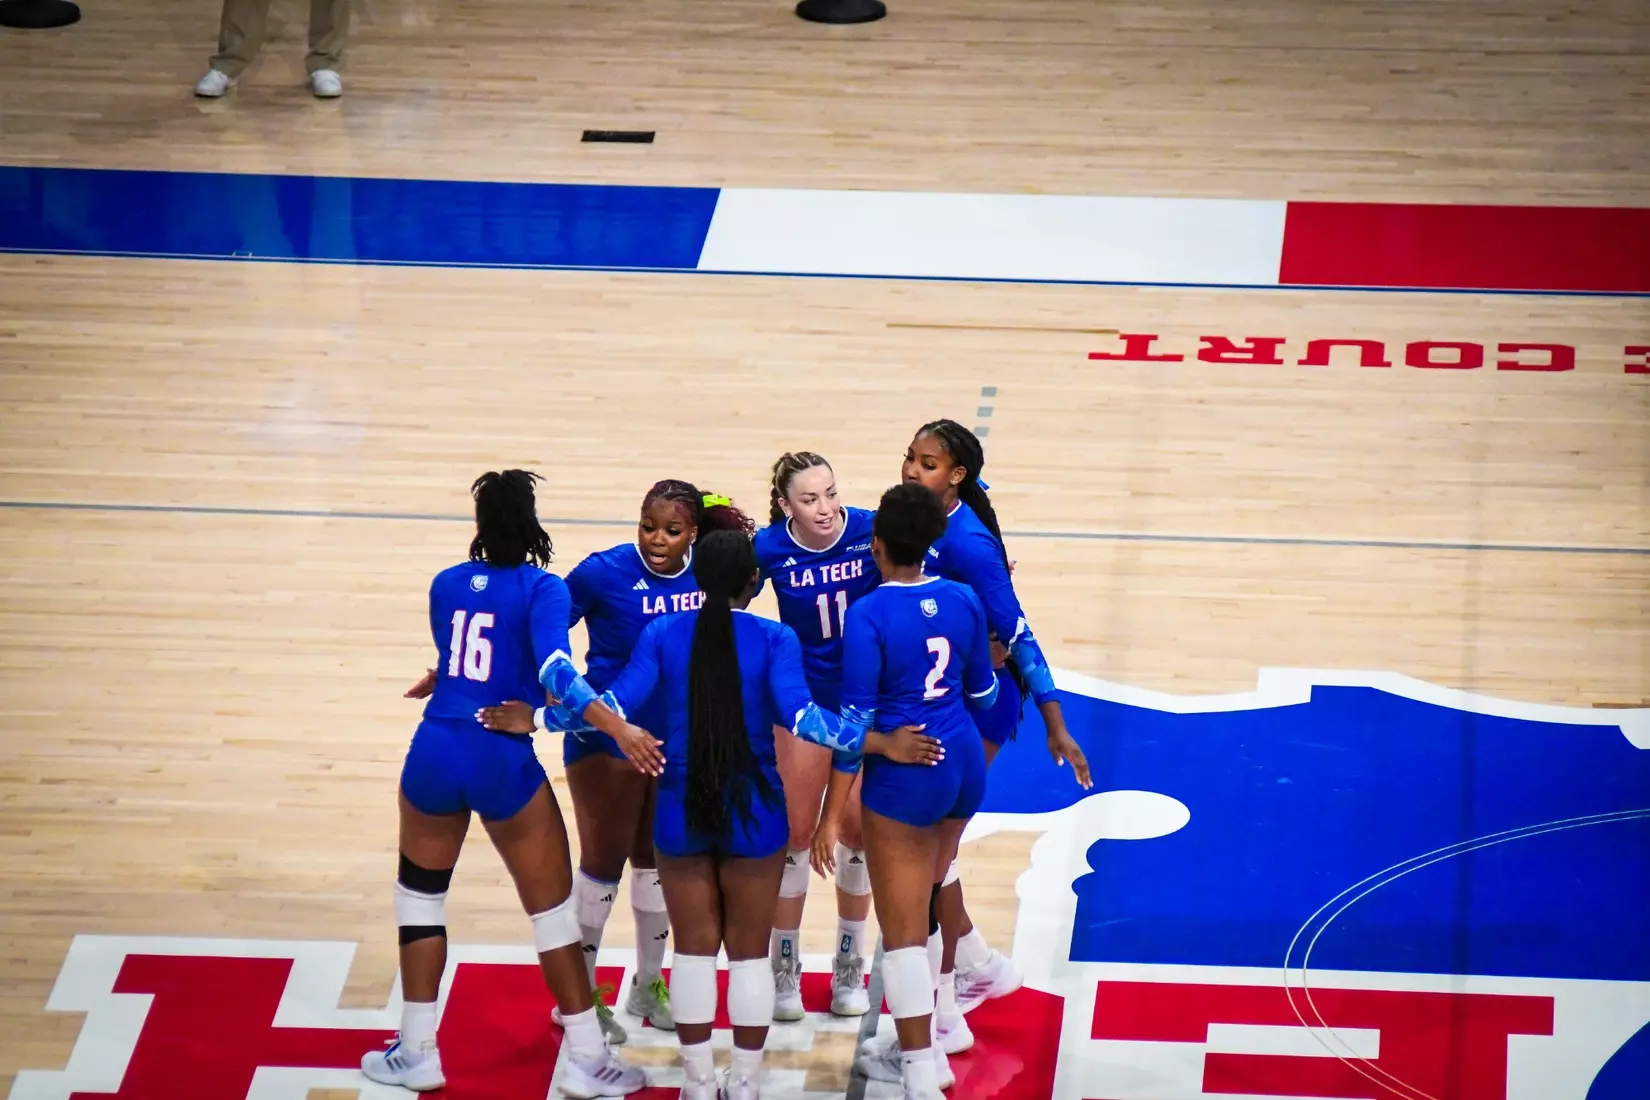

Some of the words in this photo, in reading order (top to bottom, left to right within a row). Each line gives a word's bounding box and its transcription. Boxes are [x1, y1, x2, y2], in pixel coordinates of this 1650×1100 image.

[1088, 333, 1574, 371] COURT
[790, 569, 815, 587] LA
[819, 559, 862, 583] TECH
[642, 595, 667, 615] LA
[670, 590, 707, 613] TECH
[816, 590, 847, 638] 11
[448, 610, 494, 682] 16
[923, 637, 950, 699] 2
